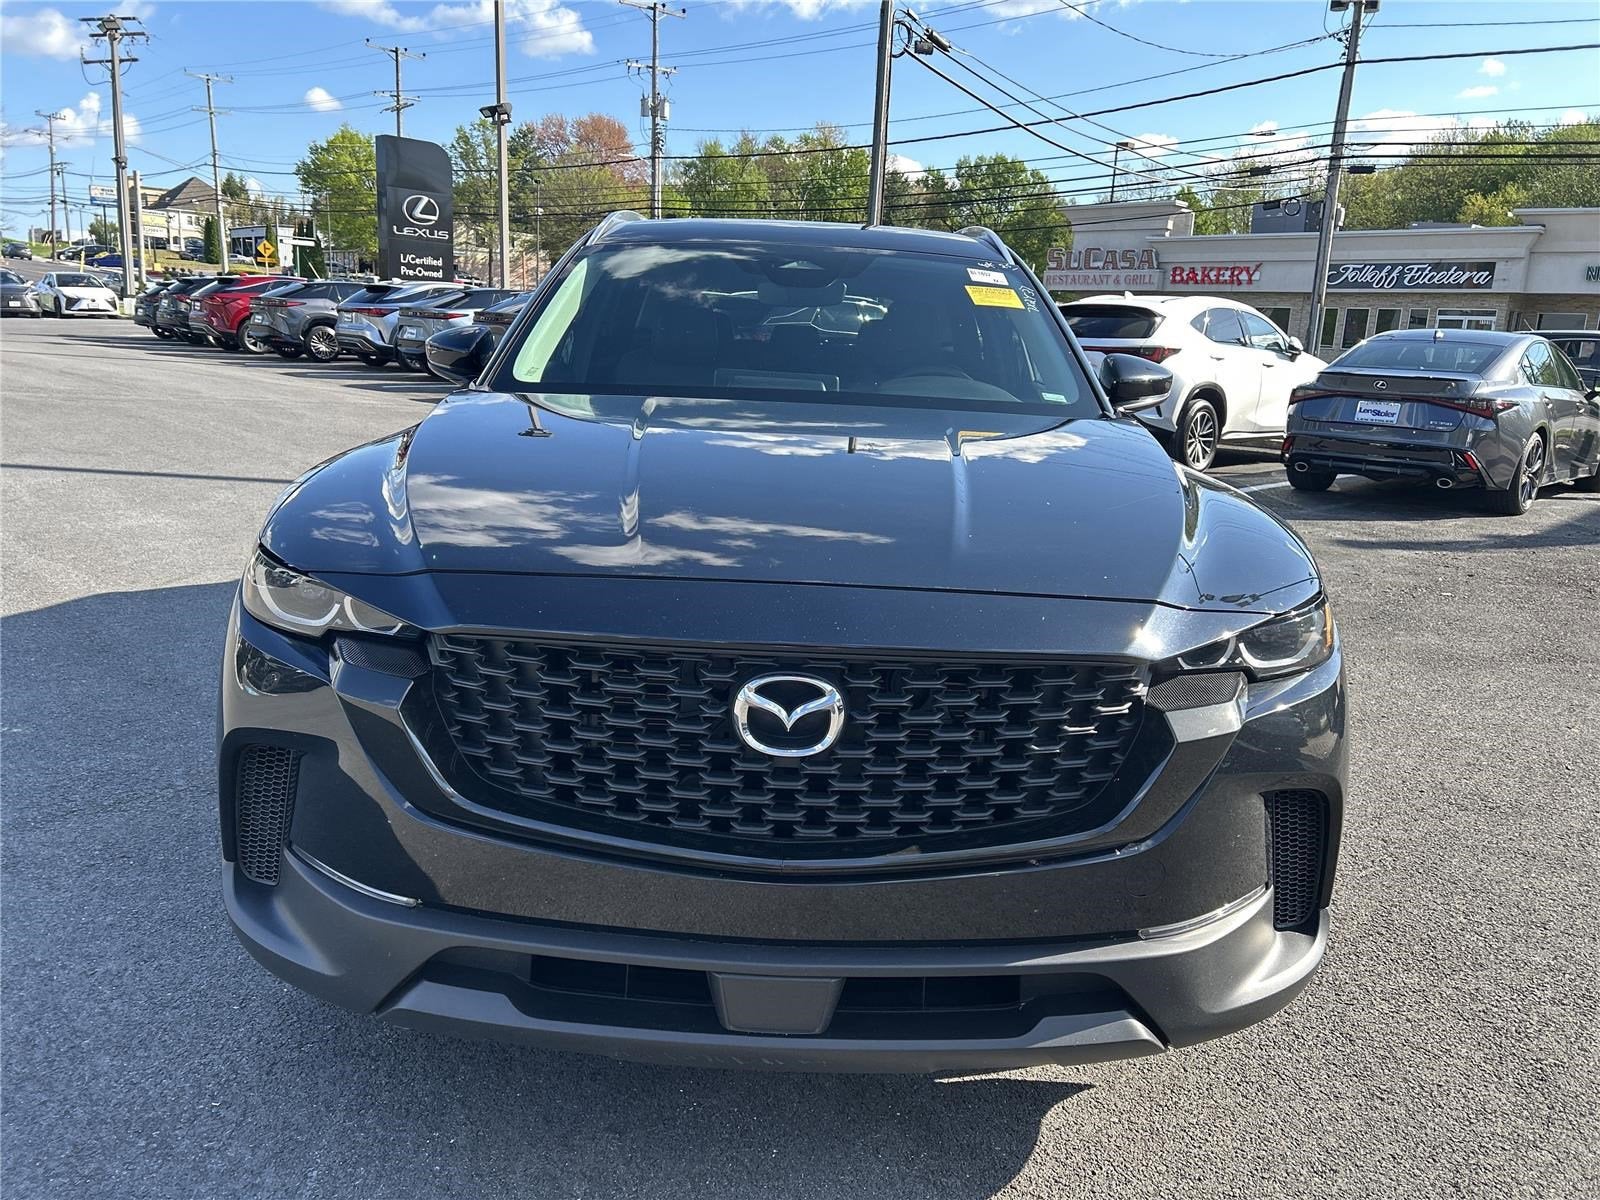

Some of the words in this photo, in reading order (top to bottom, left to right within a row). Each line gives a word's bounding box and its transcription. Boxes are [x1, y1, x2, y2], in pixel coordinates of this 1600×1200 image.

[393, 225, 449, 240] LEXUS
[400, 253, 442, 266] L/Certified
[400, 266, 442, 278] Pre-Owned
[1170, 263, 1263, 286] BAKERY
[1403, 263, 1492, 286] Etcetera
[1046, 274, 1112, 286] RESTAURANT
[1113, 274, 1120, 285] &
[1124, 274, 1154, 285] GRILL
